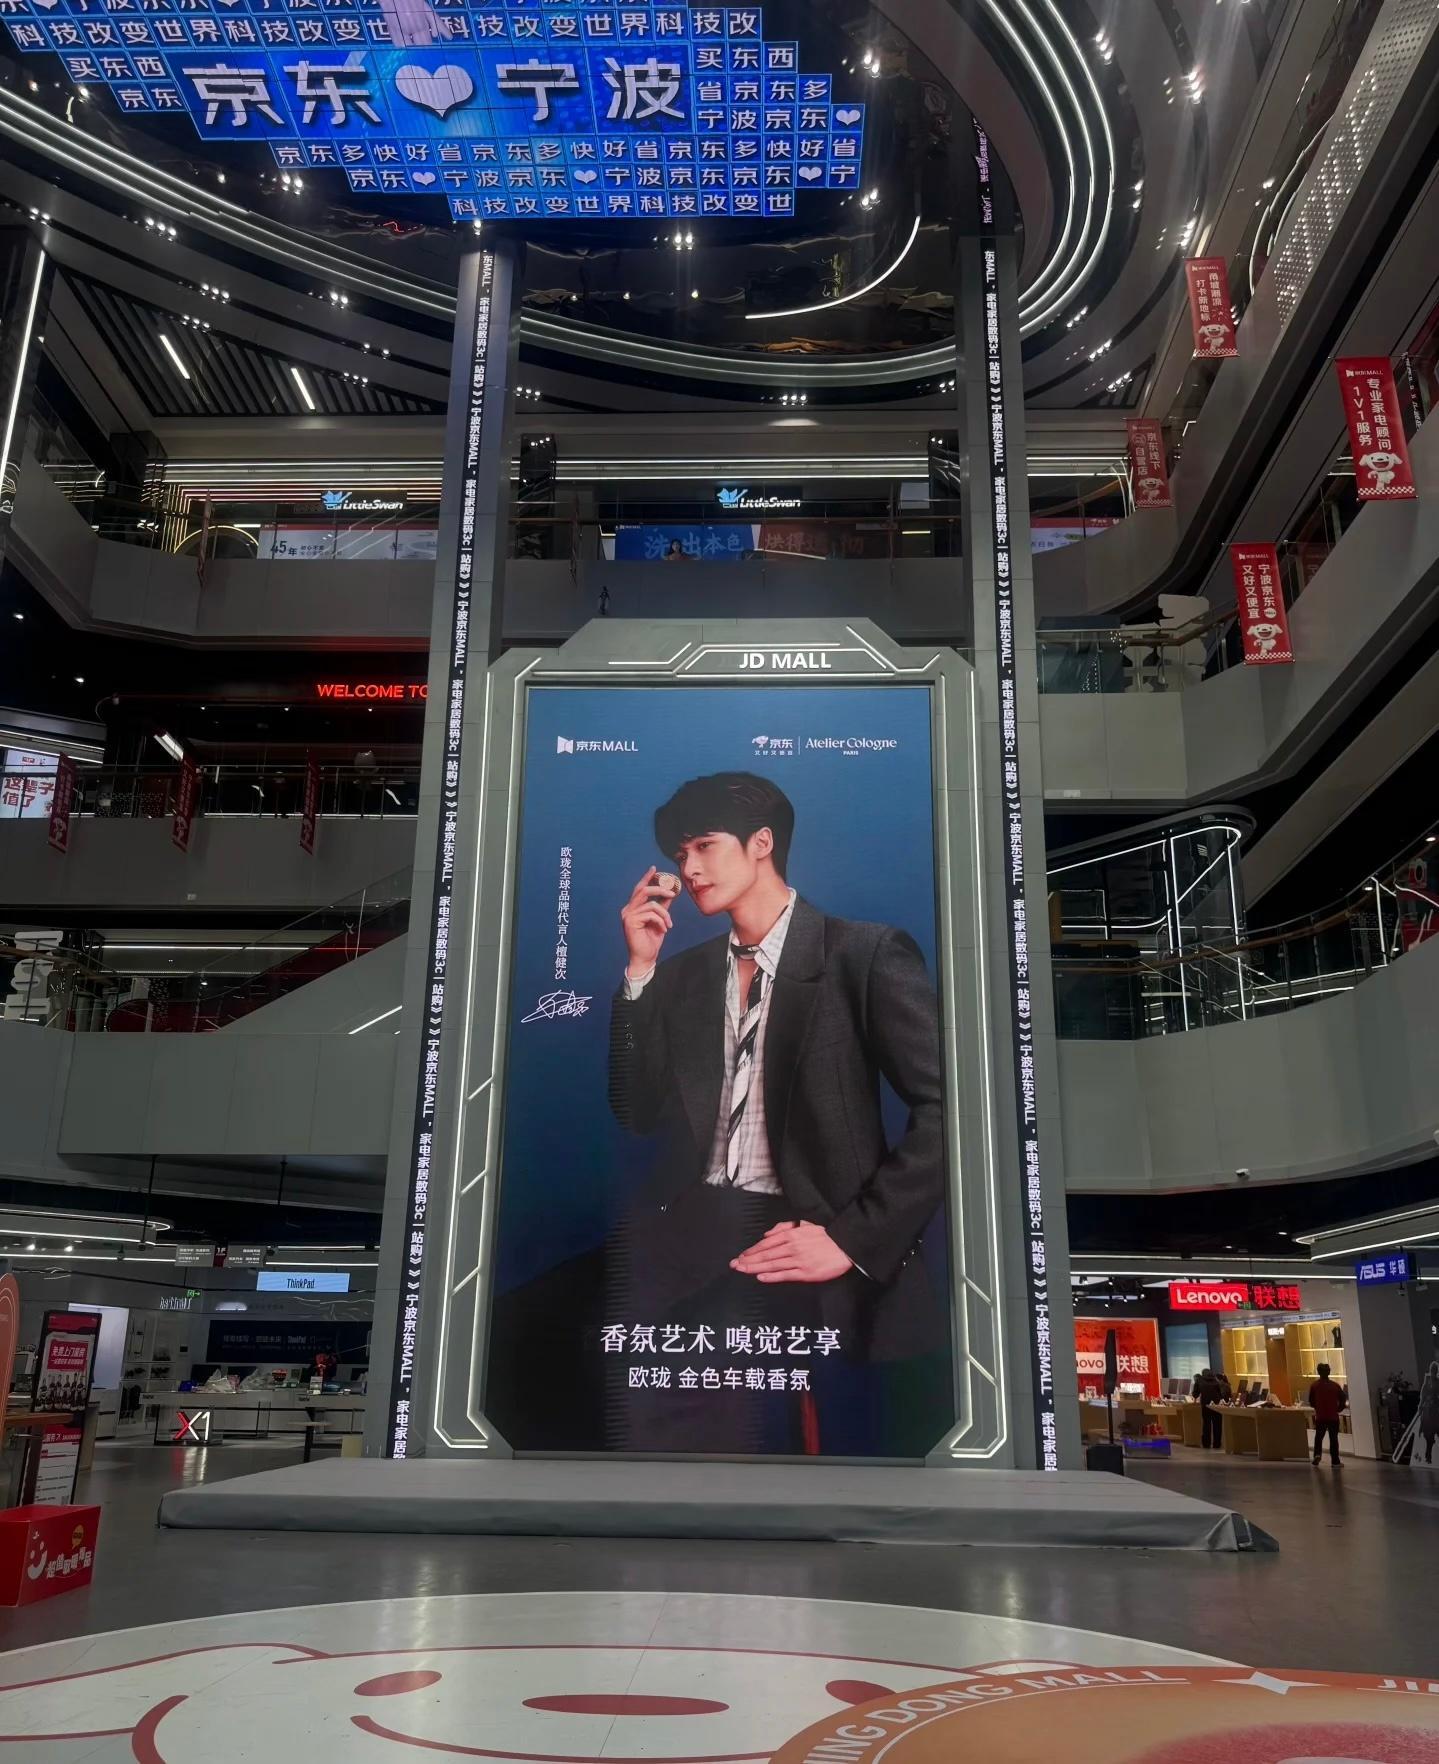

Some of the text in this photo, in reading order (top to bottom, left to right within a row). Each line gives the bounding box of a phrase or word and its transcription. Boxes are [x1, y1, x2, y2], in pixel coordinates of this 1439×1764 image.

[183, 57, 686, 127] 京东 宁波
[452, 192, 794, 216] 科技改变世界科技改变世
[1367, 378, 1392, 451] 专业家电顾问
[739, 496, 801, 508] LittleSwan
[1242, 565, 1261, 619] 又好又便宜
[739, 652, 832, 669] JD MALL
[317, 683, 428, 698] WELCOME TO
[575, 740, 639, 752] 京东MALL
[769, 738, 793, 749] 京东
[805, 737, 898, 751] Atelier Cologne
[1360, 1262, 1386, 1281] ASUS
[286, 1278, 316, 1290] ThinkPad
[1175, 1285, 1301, 1309] Lenovo 联想
[600, 1323, 842, 1356] 香氛艺术 嗅觉艺享
[628, 1365, 812, 1392] 欧珑 金色车载香氛
[172, 1411, 211, 1441] X1
[864, 1684, 1013, 1726] DONG
[1014, 1670, 1189, 1690] MALL
